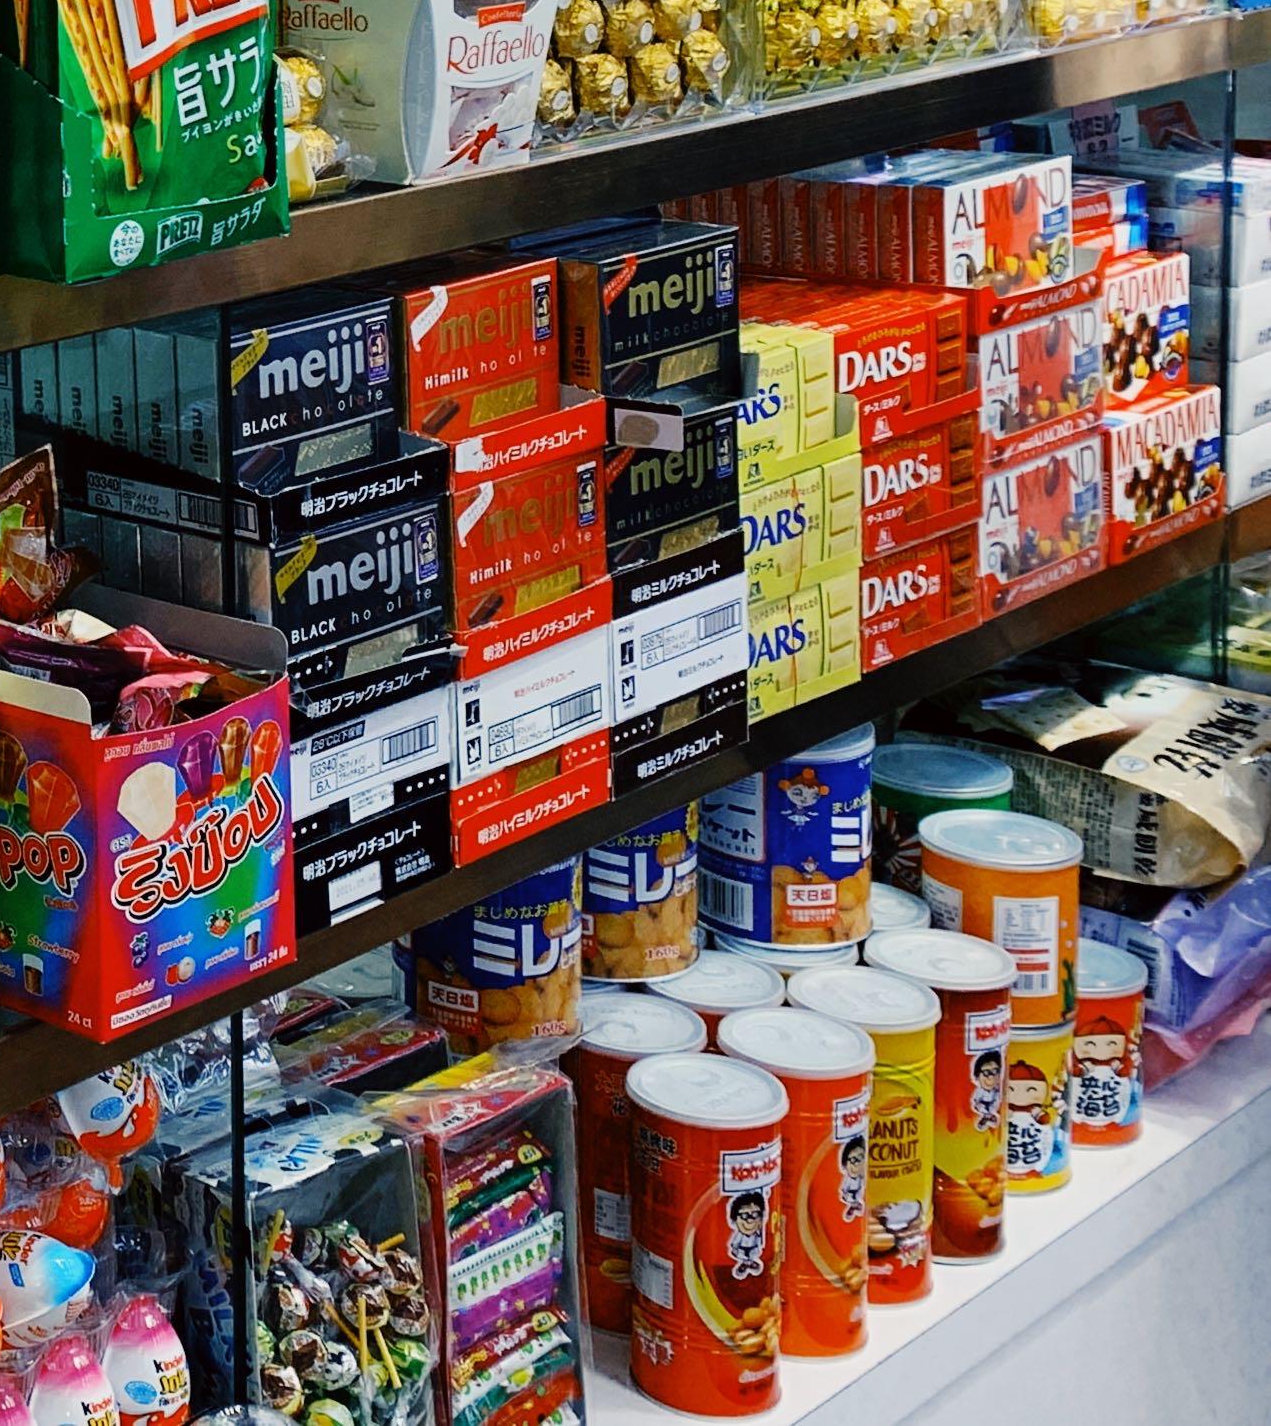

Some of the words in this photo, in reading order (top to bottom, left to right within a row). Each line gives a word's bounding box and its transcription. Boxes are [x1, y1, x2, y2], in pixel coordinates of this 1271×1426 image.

[447, 35, 545, 73] Raffaello
[952, 167, 1066, 235] ALMOND
[629, 253, 716, 318] meiji
[259, 324, 365, 398] meiji
[839, 341, 913, 394] DARS
[987, 308, 1097, 381] ALMOND
[242, 415, 287, 438] BLACK
[1116, 400, 1218, 470] MACADAMIA
[301, 471, 423, 517] 明治ブラックチョコレート
[864, 454, 928, 506] DARS
[306, 523, 413, 606] meiji
[631, 560, 721, 603] 明治ミルクチョコレート
[863, 568, 927, 615] DARS
[291, 623, 336, 646] BLACK
[483, 606, 595, 662] 明治ハイミルクチョコレート
[306, 668, 430, 718] 明治ブラックチョコレート
[637, 731, 723, 778] 明治ミルクチョコレート
[477, 785, 590, 846] 明治ハイミルクチョコレート
[792, 887, 836, 904] 天日塩
[28, 934, 79, 963] Strawberry
[474, 920, 581, 977] ミレー
[432, 986, 474, 1007] 天日塩
